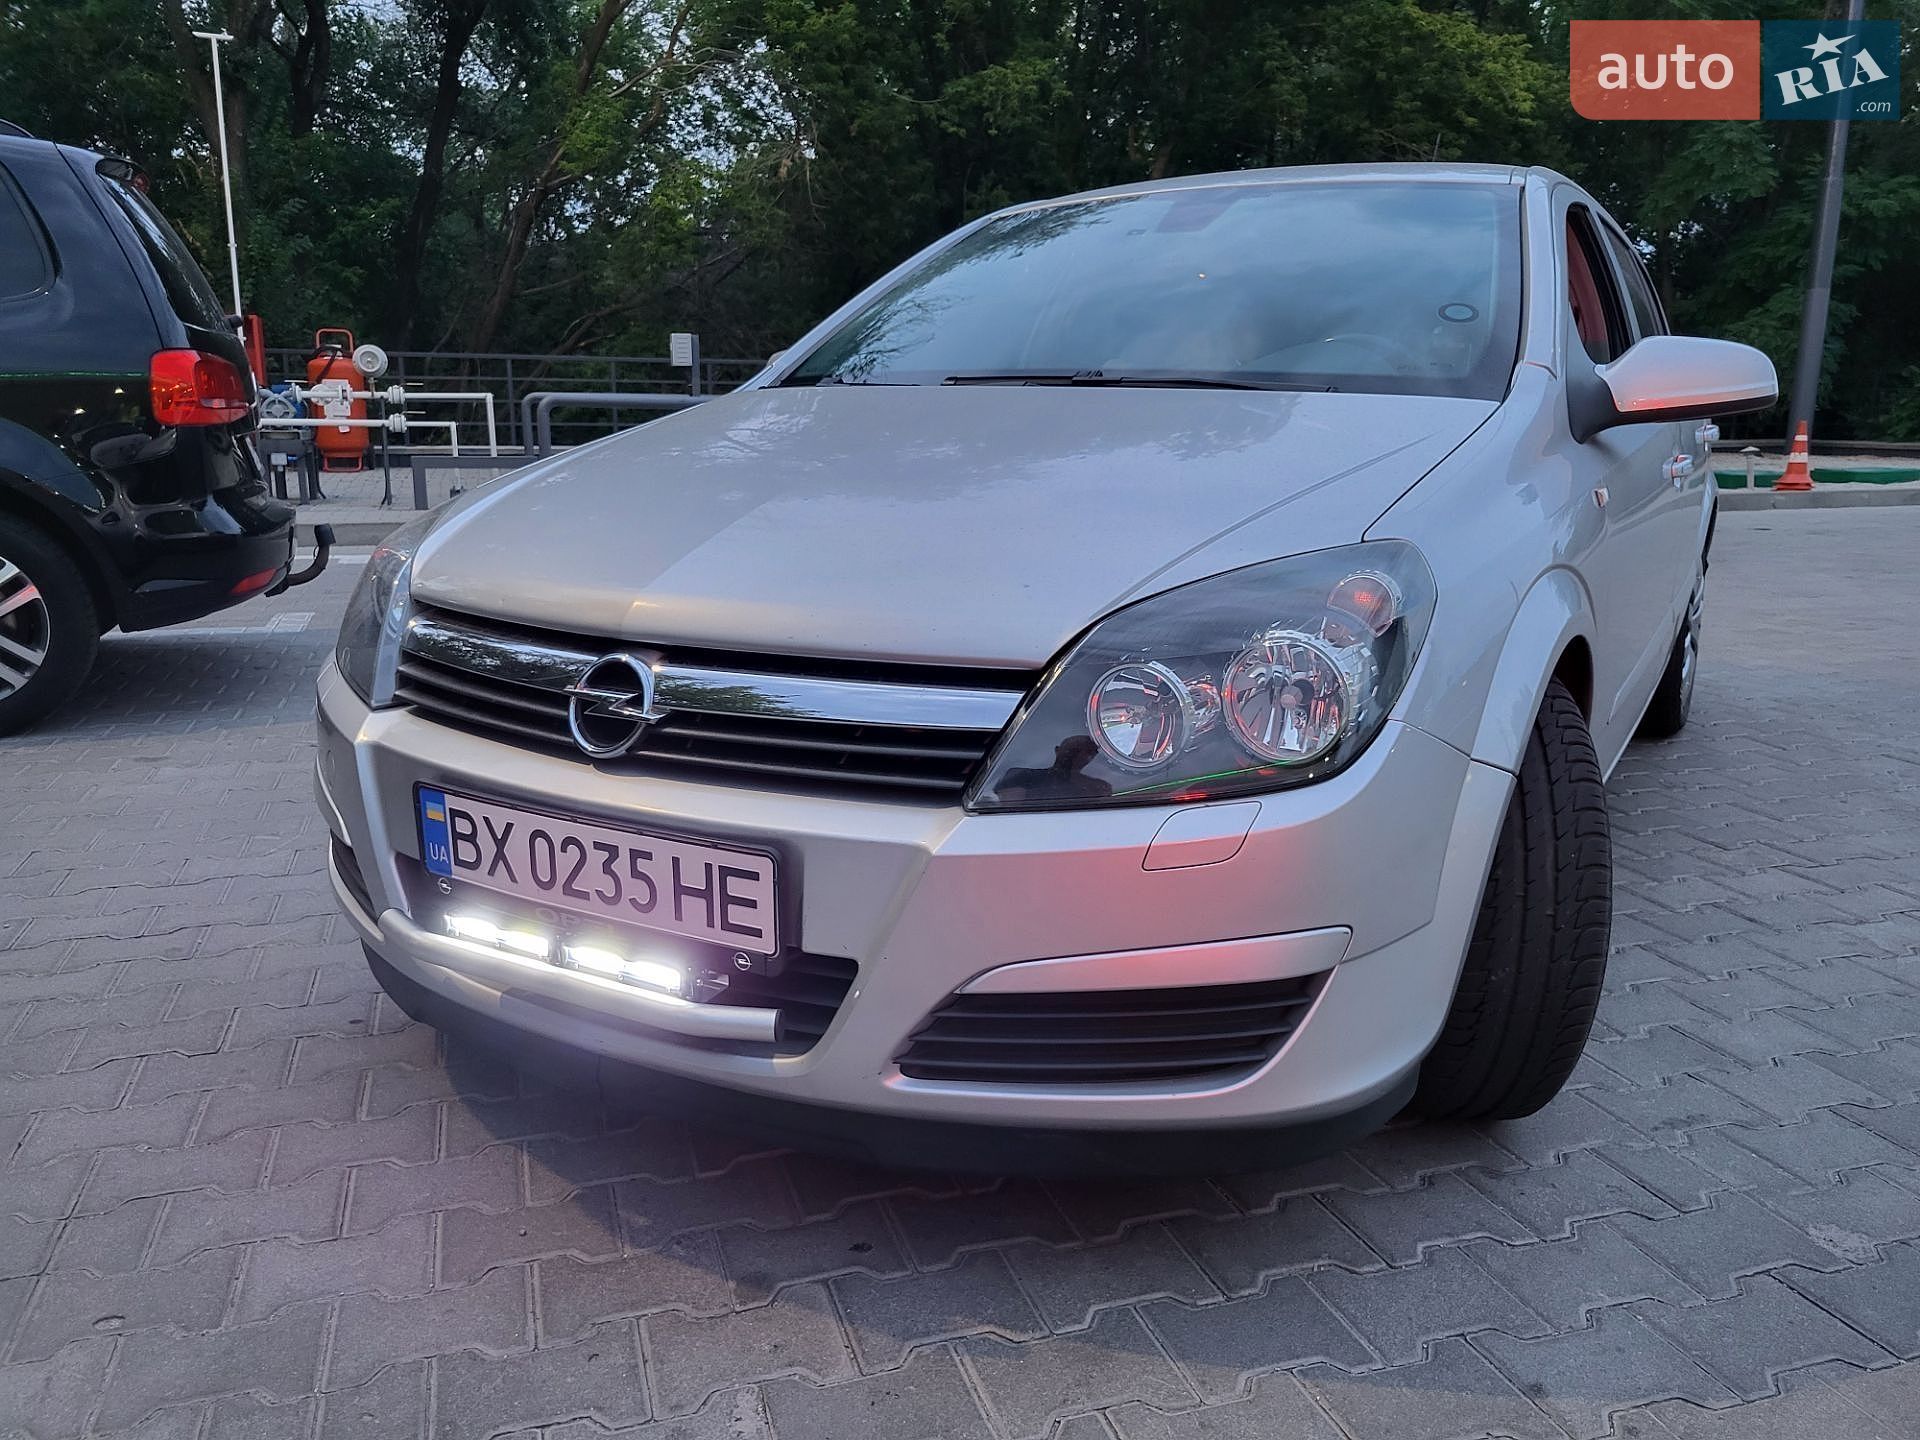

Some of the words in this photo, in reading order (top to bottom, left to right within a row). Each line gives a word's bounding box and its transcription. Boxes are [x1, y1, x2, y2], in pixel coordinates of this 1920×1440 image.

[429, 841, 449, 865] UA
[449, 807, 519, 884] BX
[528, 828, 658, 914] 0235
[671, 856, 763, 939] HE
